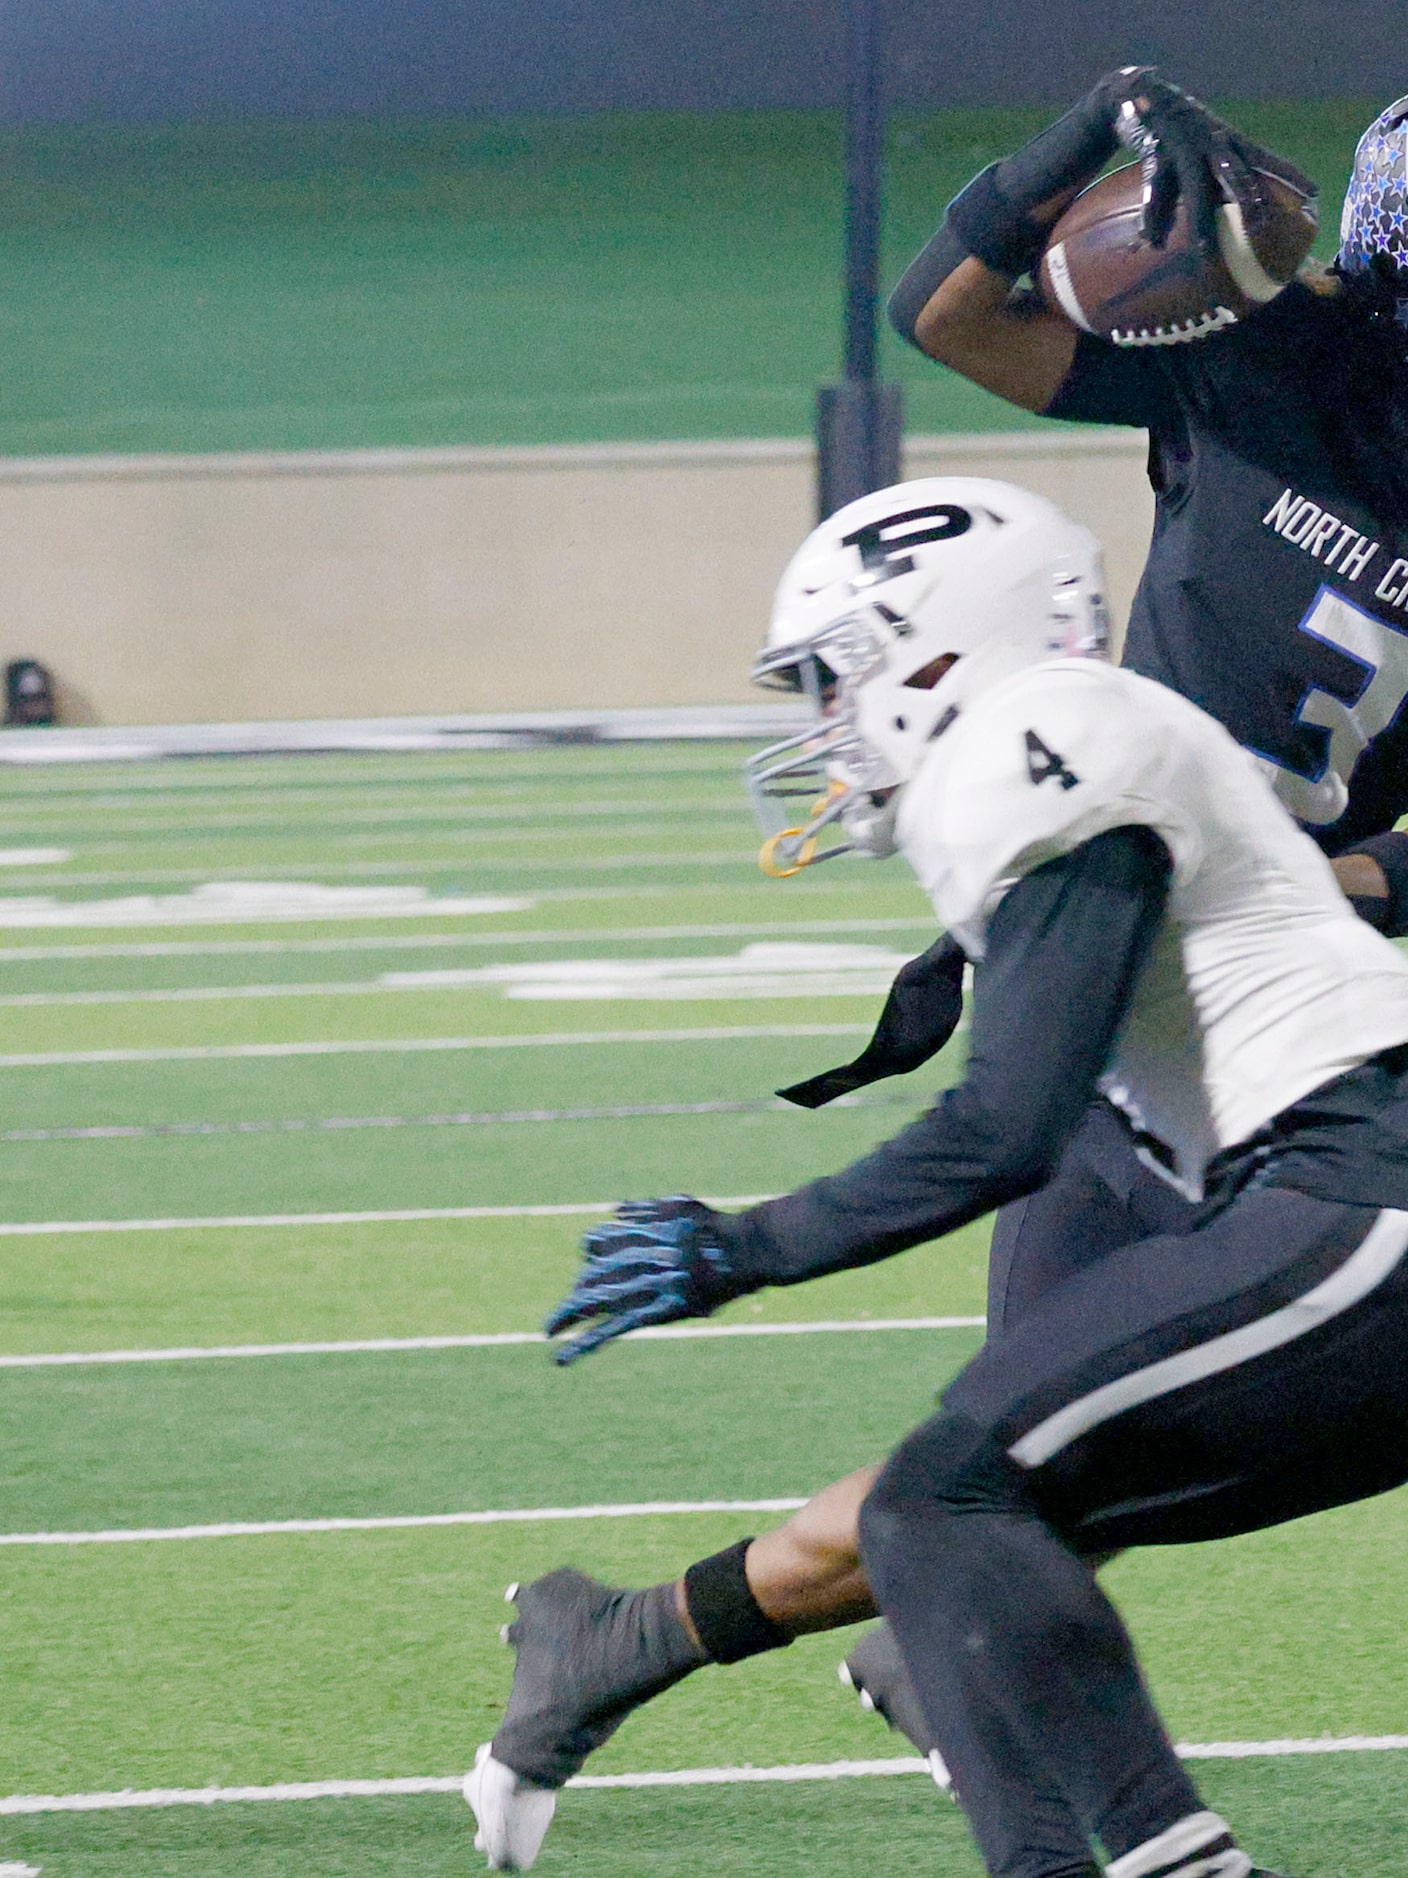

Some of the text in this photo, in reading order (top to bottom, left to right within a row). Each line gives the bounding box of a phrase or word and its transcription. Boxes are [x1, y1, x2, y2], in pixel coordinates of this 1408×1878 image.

[841, 504, 972, 593] P
[1262, 487, 1380, 581] NORTH
[1024, 729, 1080, 791] 4
